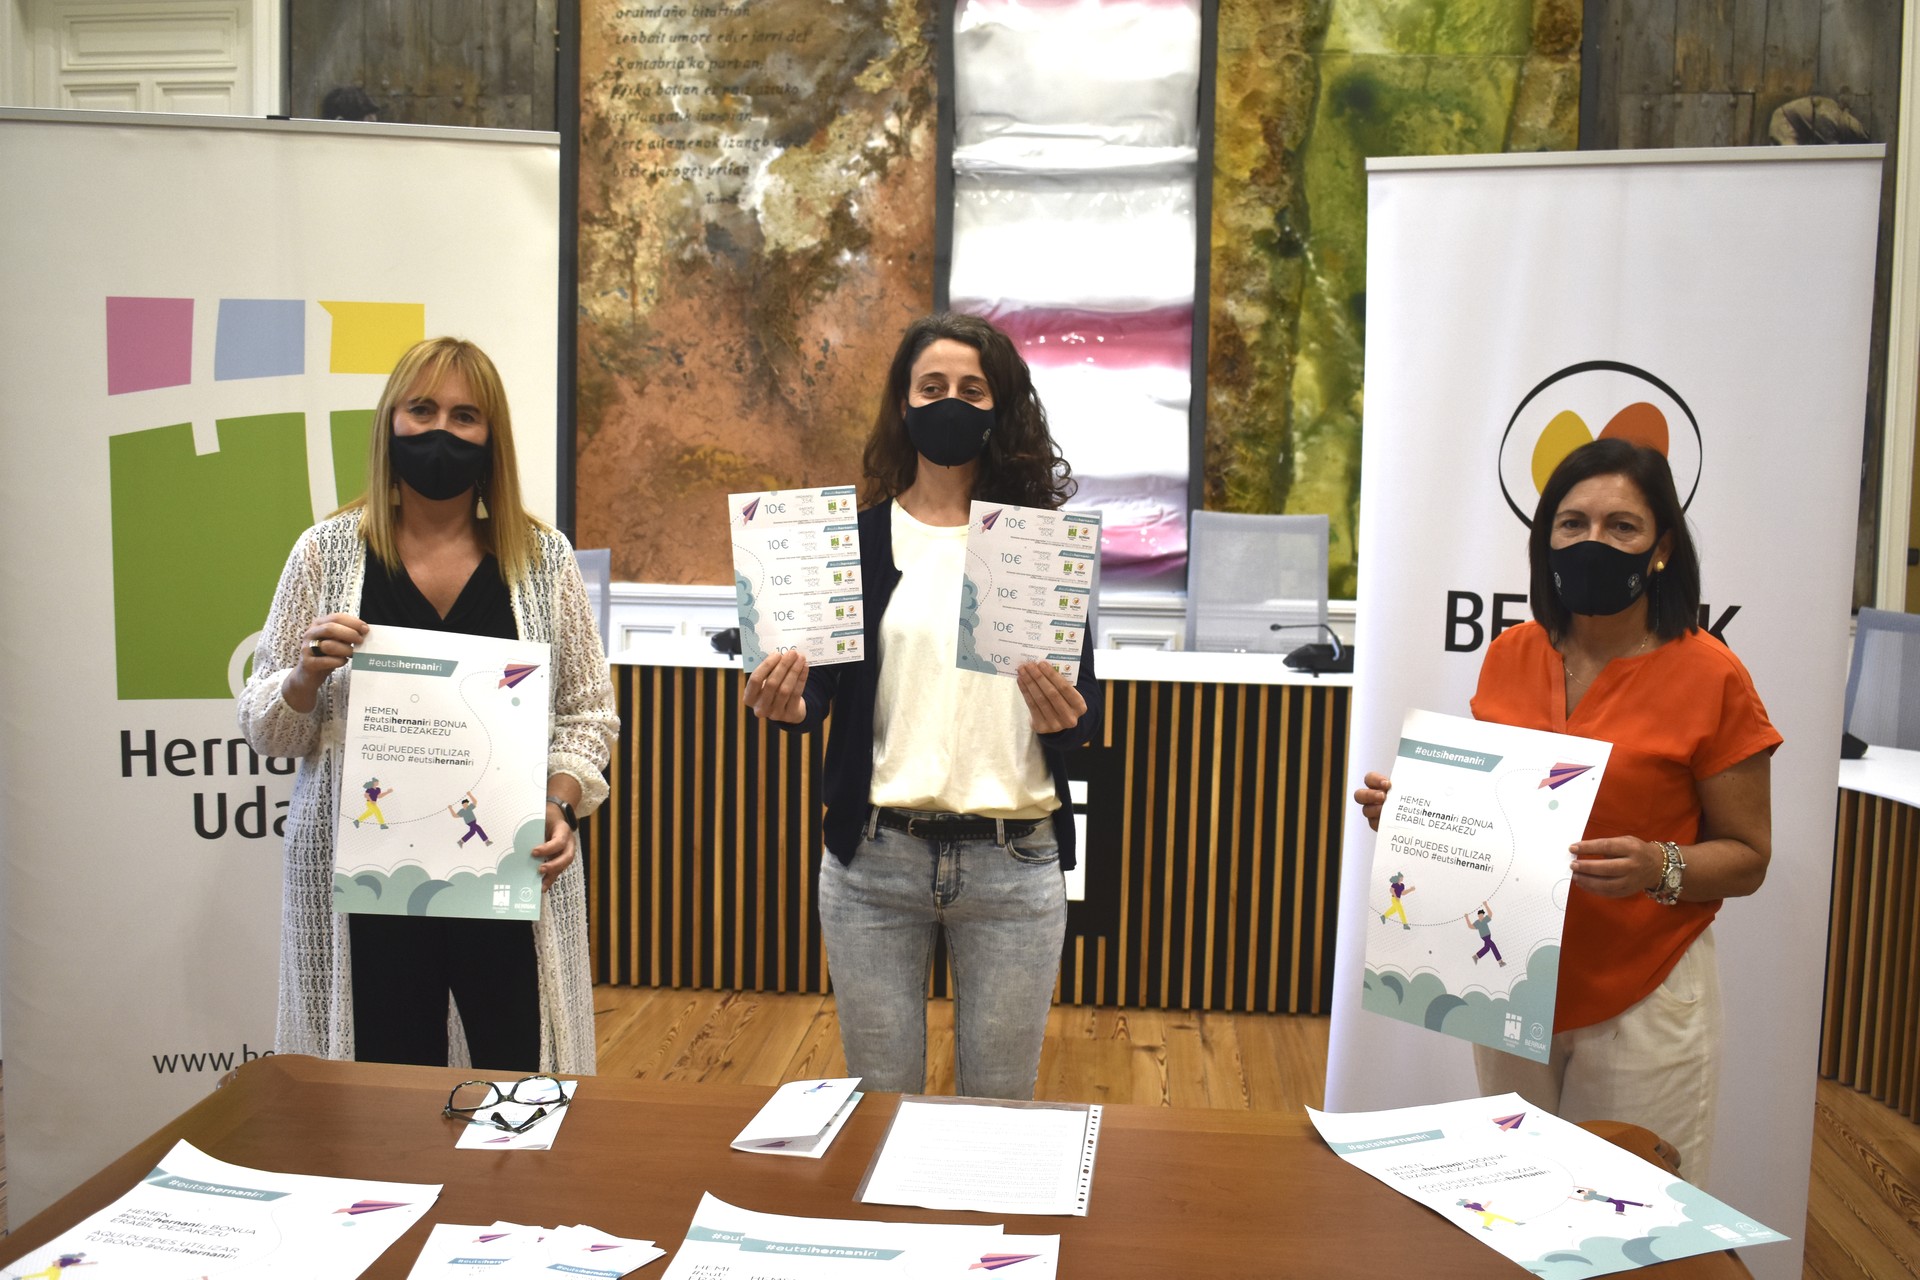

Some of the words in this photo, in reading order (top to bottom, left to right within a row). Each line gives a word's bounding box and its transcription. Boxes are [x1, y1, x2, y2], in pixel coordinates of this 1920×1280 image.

[765, 503, 787, 515] 10€
[1005, 517, 1026, 530] 10€
[768, 538, 789, 550] 10€
[1001, 553, 1022, 565] 10€
[770, 574, 792, 586] 10€
[997, 587, 1018, 600] 10€
[773, 610, 795, 621] 10€
[993, 621, 1014, 634] 10€
[368, 658, 443, 672] #eutsihernaniri
[990, 653, 1011, 666] 10€
[364, 706, 399, 716] HEMEN
[364, 715, 432, 727] #eutsihernaniri
[434, 719, 468, 729] BONUA
[363, 724, 397, 734] ERABIL
[400, 726, 452, 737] DEZAKEZU
[120, 730, 295, 777] Herna
[361, 743, 387, 754] AQUÍ
[388, 745, 427, 756] PUEDES
[428, 748, 471, 758] UTILIZAR
[1415, 745, 1486, 767] #eutsihernaniri
[361, 752, 374, 761] TU
[376, 753, 405, 763] BONO
[408, 755, 474, 767] #eutsihernaniri
[1400, 795, 1431, 807] HEMEN
[193, 785, 291, 840] Uda
[1398, 804, 1460, 823] #eutsihernaniri
[1461, 815, 1494, 830] BONUA
[1395, 813, 1426, 827] ERABIL
[1428, 820, 1477, 836] DEZAKEZU
[1391, 834, 1414, 848] AQUÍ
[1414, 838, 1449, 854] PUEDES
[1451, 845, 1492, 862] UTILIZAR
[1390, 843, 1402, 853] TU
[1403, 846, 1430, 860] BONO
[1431, 852, 1494, 873] #eutsihernaniri
[168, 1179, 266, 1199] #eutsihernaniri
[126, 1208, 172, 1218] HEMEN
[110, 1218, 153, 1229] ERABIL
[158, 1224, 230, 1237] DEZAKEZU
[118, 1213, 208, 1229] #eutsihernaniri
[210, 1225, 257, 1235] BONUA
[103, 1237, 143, 1248] BONO
[126, 1234, 177, 1246] PUEDES
[180, 1241, 241, 1253] UTILIZAR
[711, 1233, 745, 1242] #eut
[765, 1244, 878, 1258] #eutsihernaniri
